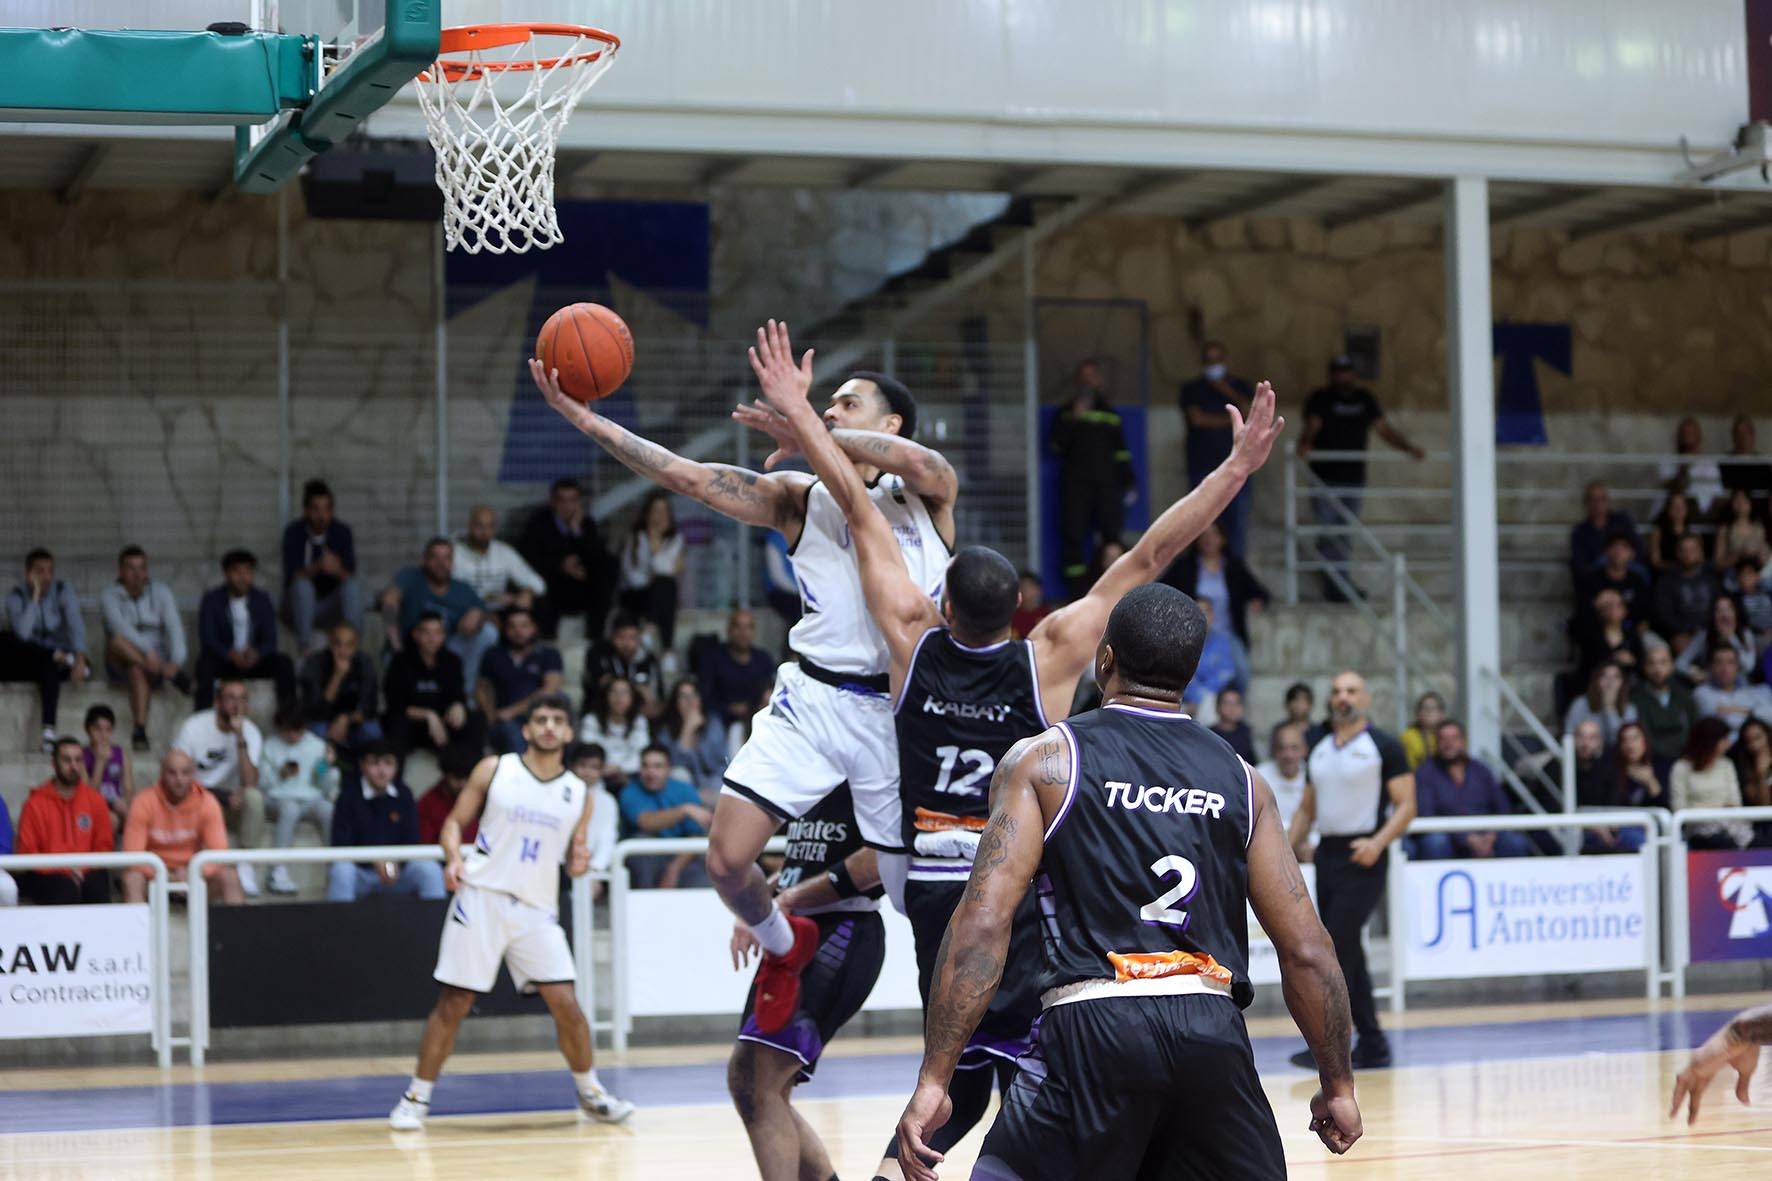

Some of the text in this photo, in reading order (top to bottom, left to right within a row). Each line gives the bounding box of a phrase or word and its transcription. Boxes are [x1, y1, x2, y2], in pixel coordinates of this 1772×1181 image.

[933, 745, 995, 797] 12
[1104, 781, 1226, 820] TUCKER
[520, 836, 540, 863] 14
[1140, 854, 1199, 930] 2
[1485, 872, 1633, 907] Université
[1487, 905, 1642, 945] Antonine
[10, 978, 150, 1005] Contracting
